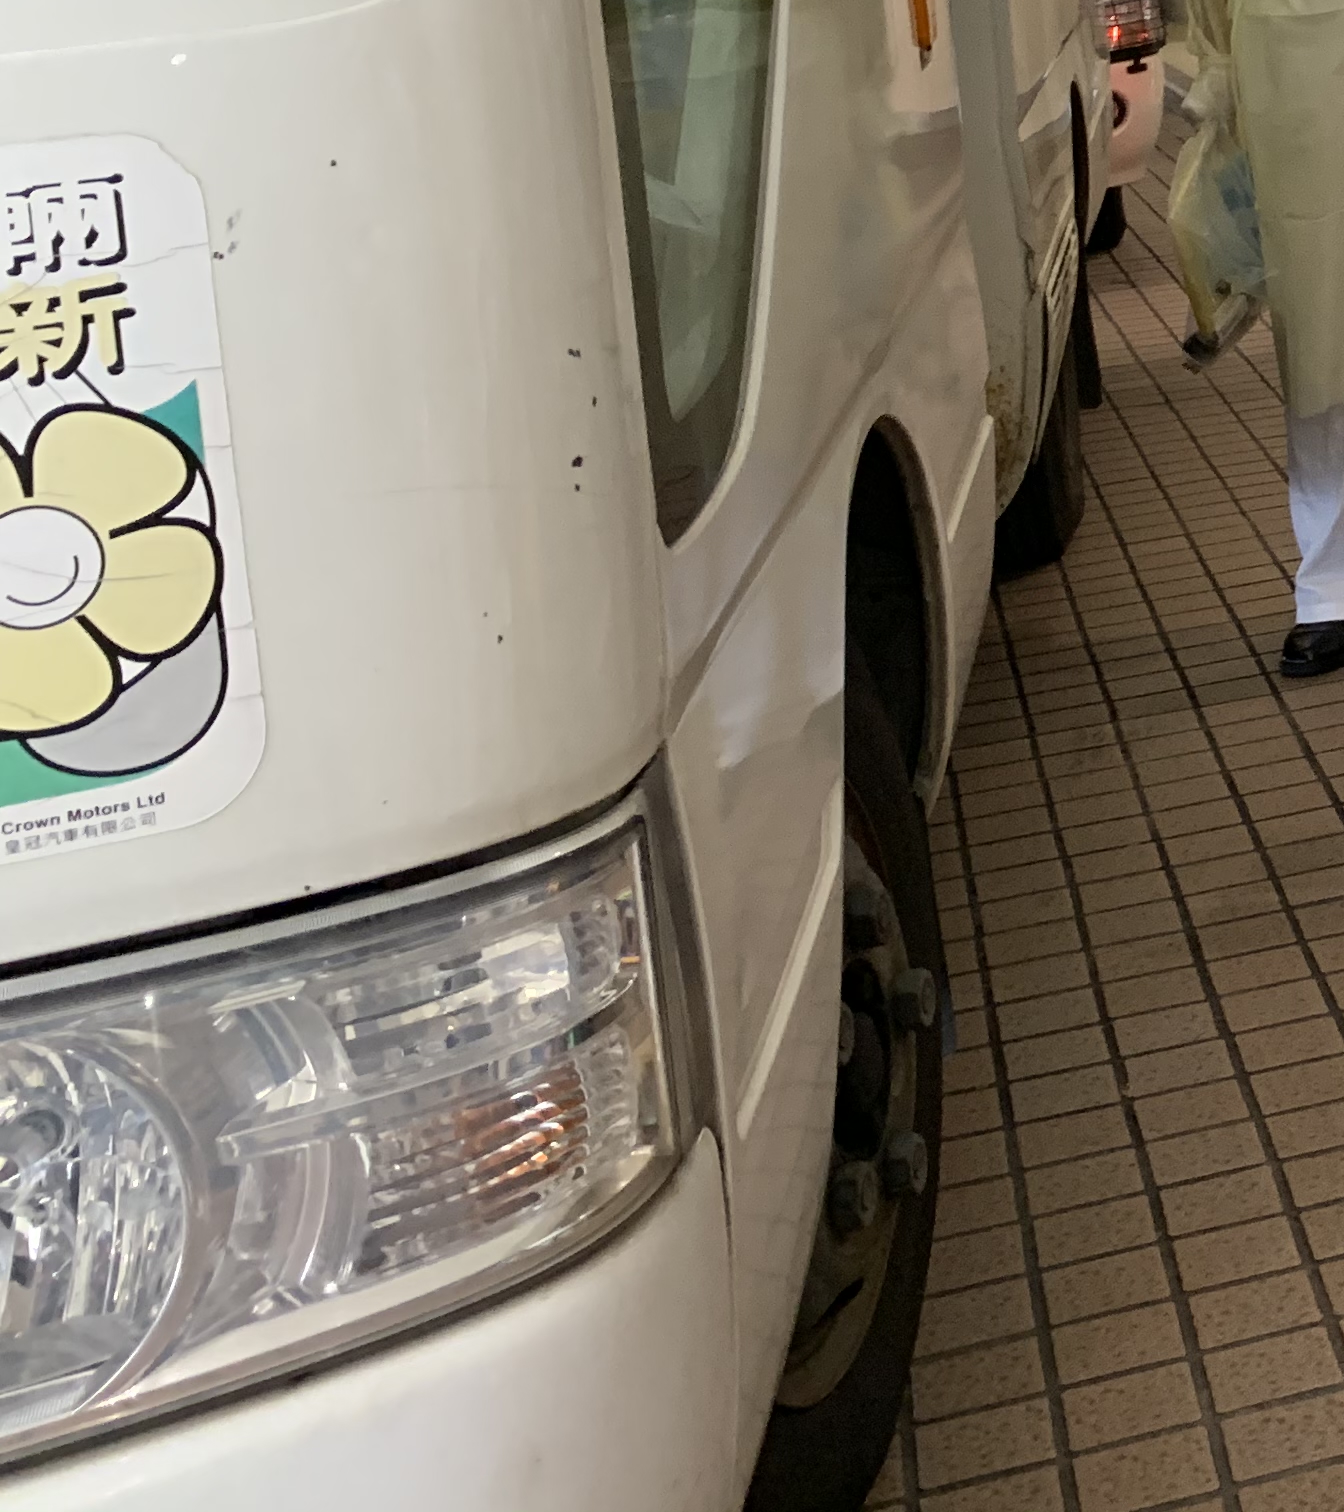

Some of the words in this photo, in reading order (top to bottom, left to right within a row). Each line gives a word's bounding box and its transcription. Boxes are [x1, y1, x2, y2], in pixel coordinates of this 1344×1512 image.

[1, 815, 61, 835] Crown
[67, 800, 130, 822] Motors
[137, 791, 166, 809] Ltd
